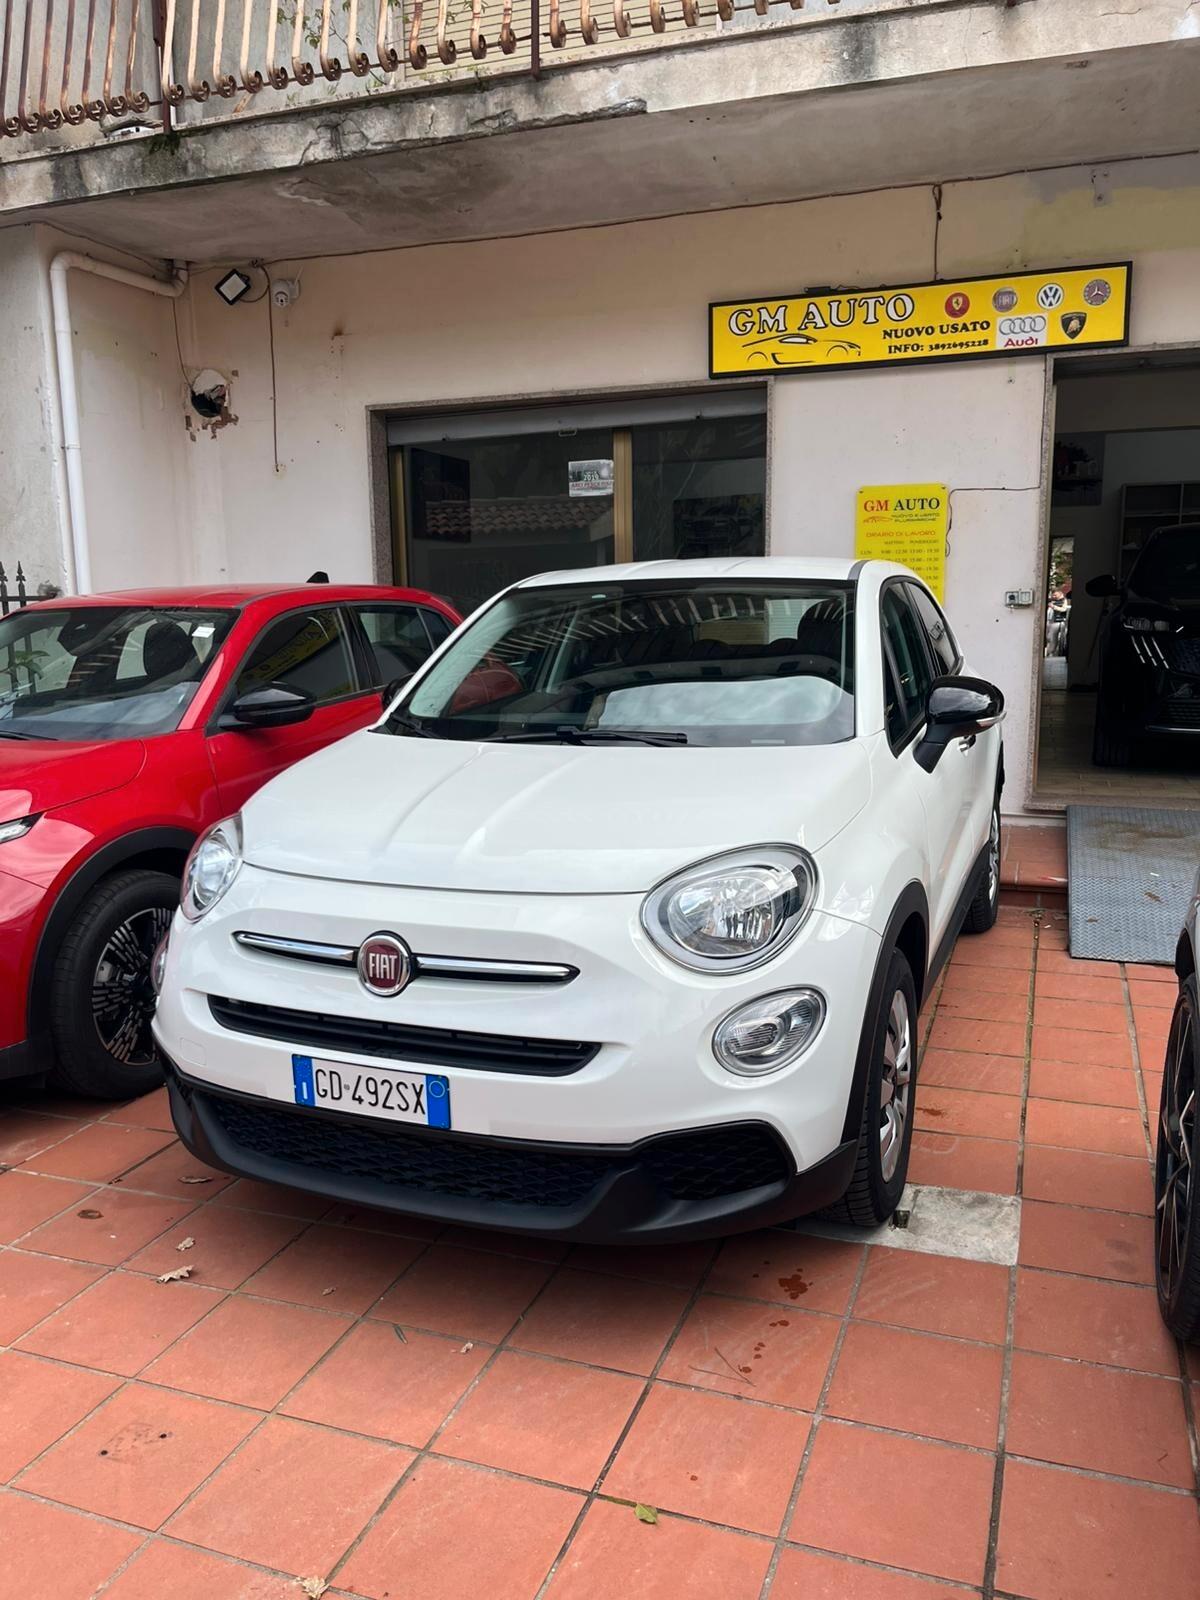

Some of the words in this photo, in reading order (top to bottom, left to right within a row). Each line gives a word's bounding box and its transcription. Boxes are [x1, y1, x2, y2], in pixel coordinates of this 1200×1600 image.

[729, 304, 788, 336] GM
[797, 294, 916, 330] AUTO
[882, 323, 935, 340] NUOVO
[939, 320, 991, 335] USATO
[887, 343, 924, 354] INFO:
[1004, 337, 1039, 348] Audi
[863, 500, 890, 512] GM
[894, 497, 940, 511] AUTO
[368, 952, 398, 980] FIAT
